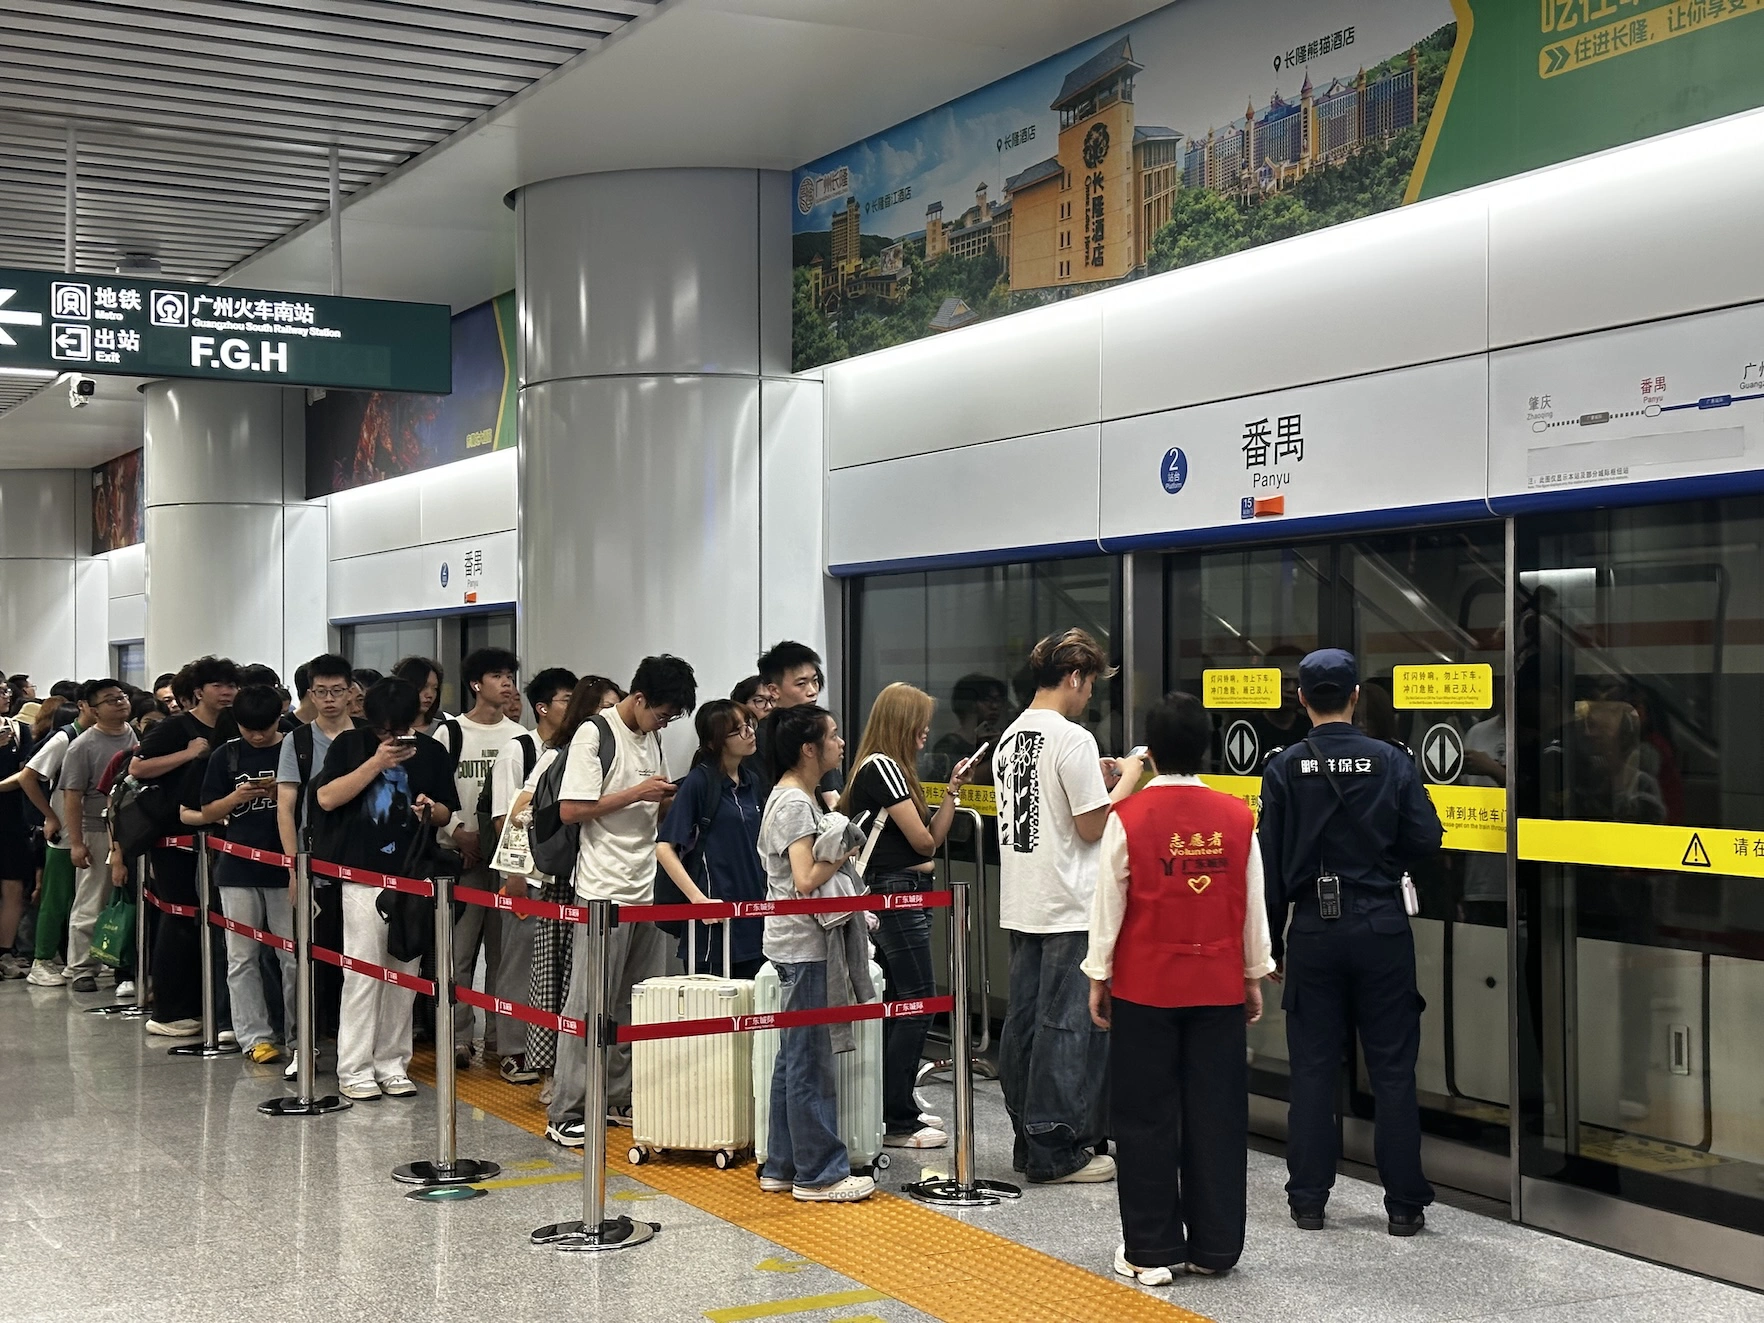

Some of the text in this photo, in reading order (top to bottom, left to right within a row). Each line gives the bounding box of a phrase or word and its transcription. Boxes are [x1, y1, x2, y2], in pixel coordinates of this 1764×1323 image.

[1284, 26, 1355, 69] 长隆熊猫酒店
[1004, 125, 1036, 150] 长隆酒店
[94, 286, 142, 311] 地铁
[94, 309, 124, 321] Metro
[191, 294, 315, 324] 广州火车南站
[191, 317, 342, 338] Guangzhou South Railway Station
[94, 328, 140, 352] 出站
[95, 350, 121, 363] Exit
[190, 335, 288, 373] F.G.H
[1640, 376, 1667, 395] 番禺
[1739, 380, 1764, 390] Guang
[1528, 394, 1552, 411] 肇庆
[1643, 395, 1664, 404] Panyu
[1526, 411, 1554, 421] Zhaoqing
[1241, 414, 1304, 470] 番禺
[1169, 448, 1179, 471] 2
[1167, 471, 1180, 482] 站台
[1253, 472, 1290, 489] Panyu
[1243, 498, 1252, 508] 15
[465, 550, 482, 577] 番禺
[1028, 769, 1040, 850] BASKETBALL
[1491, 824, 1507, 832] throug
[1169, 831, 1223, 848] 志愿者
[1169, 848, 1224, 856] Volunteer
[828, 1190, 860, 1198] crocs
